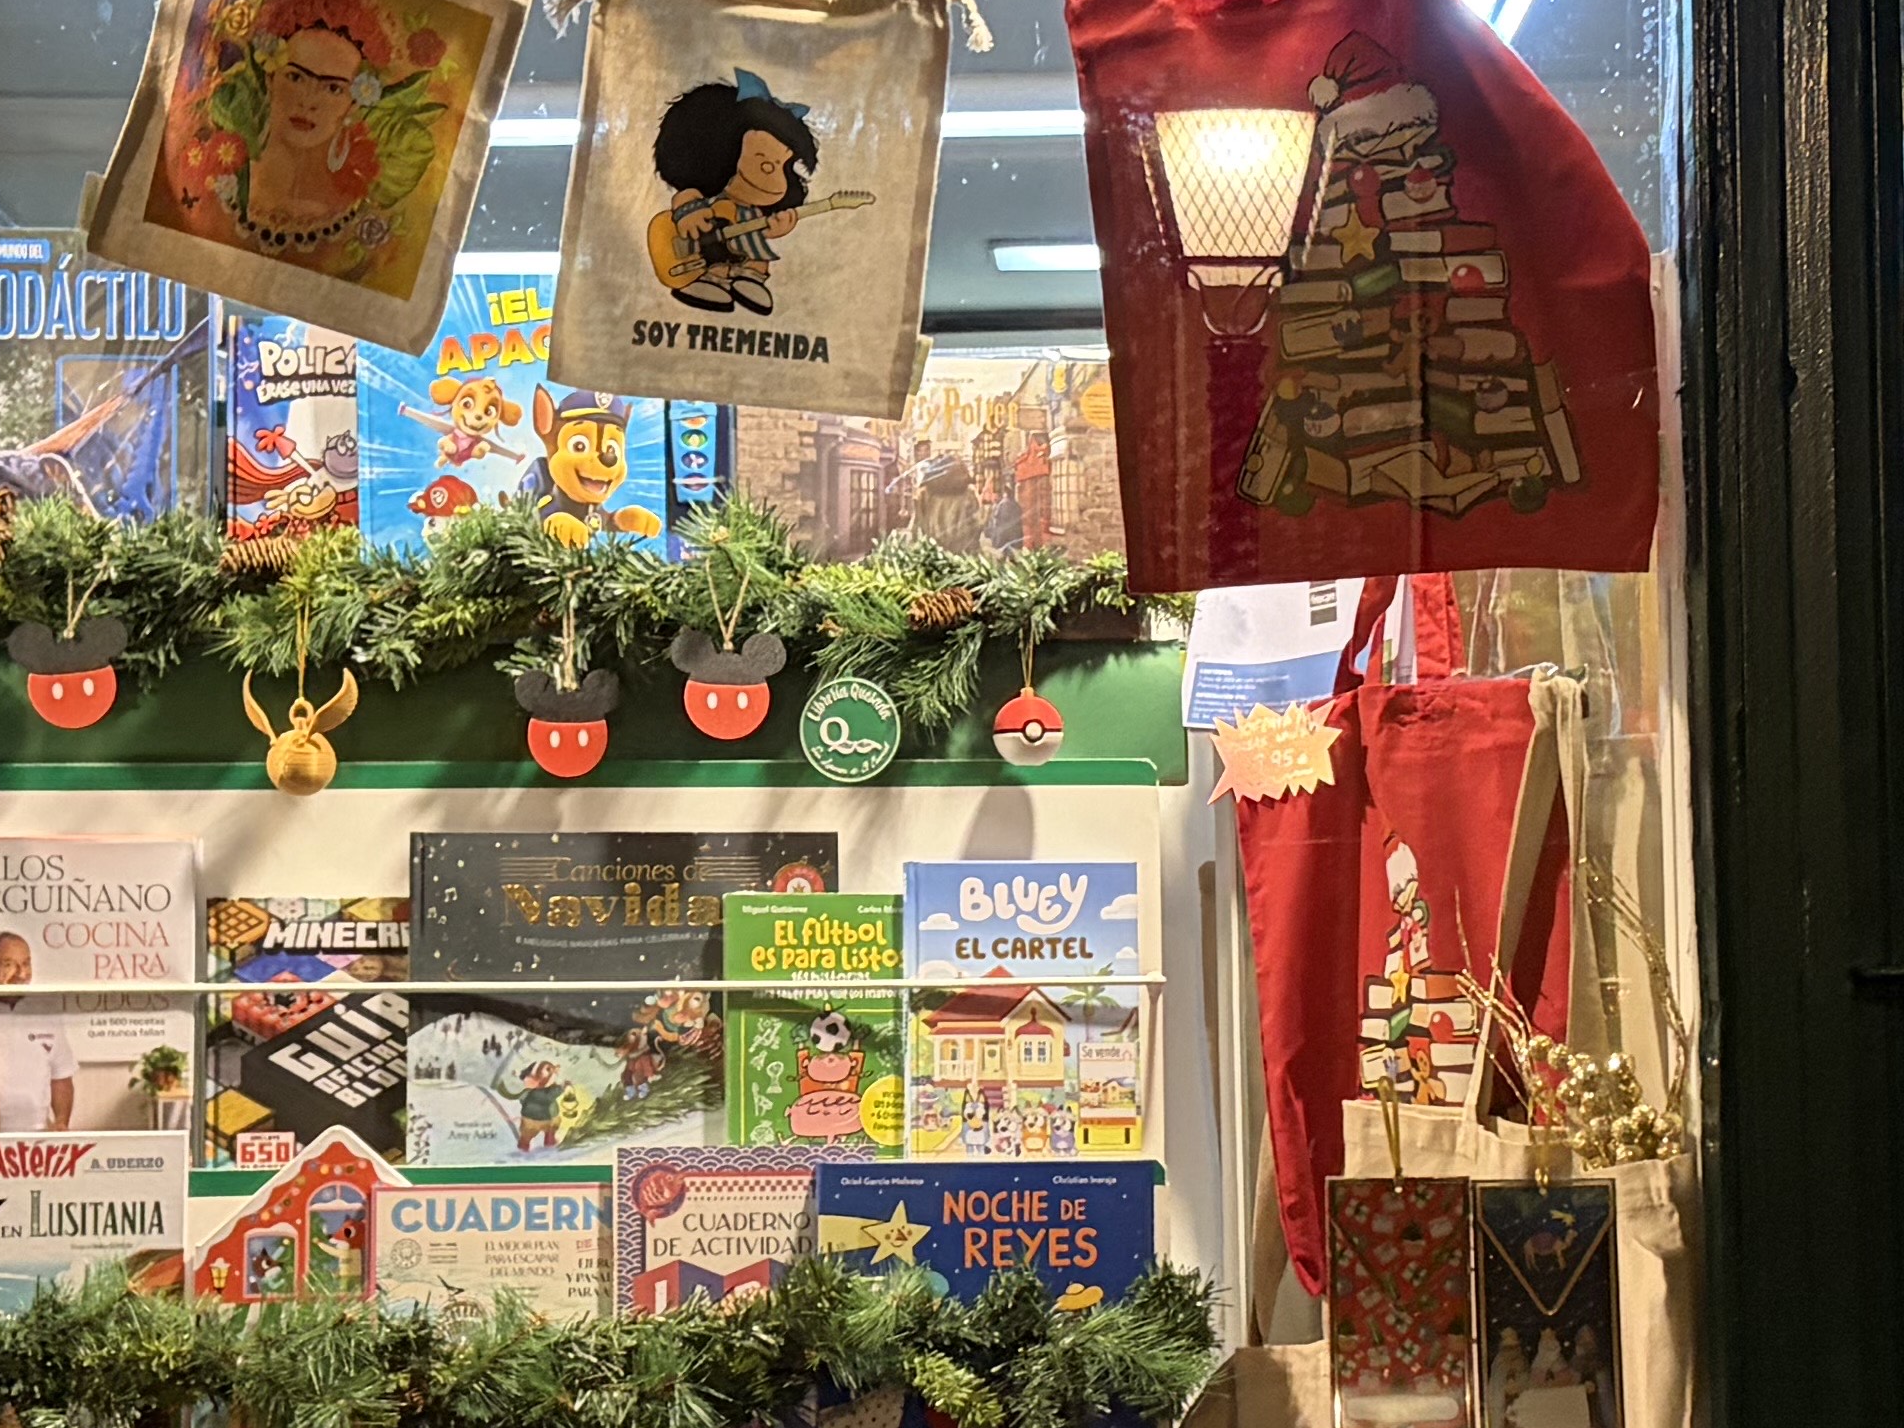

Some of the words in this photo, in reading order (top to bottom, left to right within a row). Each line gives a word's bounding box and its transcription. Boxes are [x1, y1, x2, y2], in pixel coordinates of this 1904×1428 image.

[632, 320, 681, 349] SOY
[686, 324, 829, 363] TREMENDA
[960, 873, 1087, 934] BLUEY
[42, 922, 169, 949] COCINA
[775, 920, 798, 946] El
[803, 913, 887, 946] fútbol
[751, 945, 776, 971] es
[782, 949, 835, 969] para
[956, 939, 985, 959] EL
[992, 938, 1094, 959] CARTEL
[95, 953, 170, 980] PARA
[88, 1029, 101, 1039] que
[104, 1029, 133, 1038] nunca
[135, 1027, 165, 1038] fallan
[128, 1018, 165, 1028] recetas
[1095, 1045, 1120, 1059] vende
[108, 1157, 164, 1169] UDERZO
[240, 1140, 291, 1163] 650
[2, 1225, 22, 1238] EN
[30, 1190, 165, 1237] LUSITANIA
[944, 1191, 1048, 1223] NOCHE
[1061, 1200, 1086, 1220] DE
[684, 1212, 810, 1232] CUADERNO
[654, 1237, 684, 1257] DE
[964, 1228, 1098, 1268] REYES
